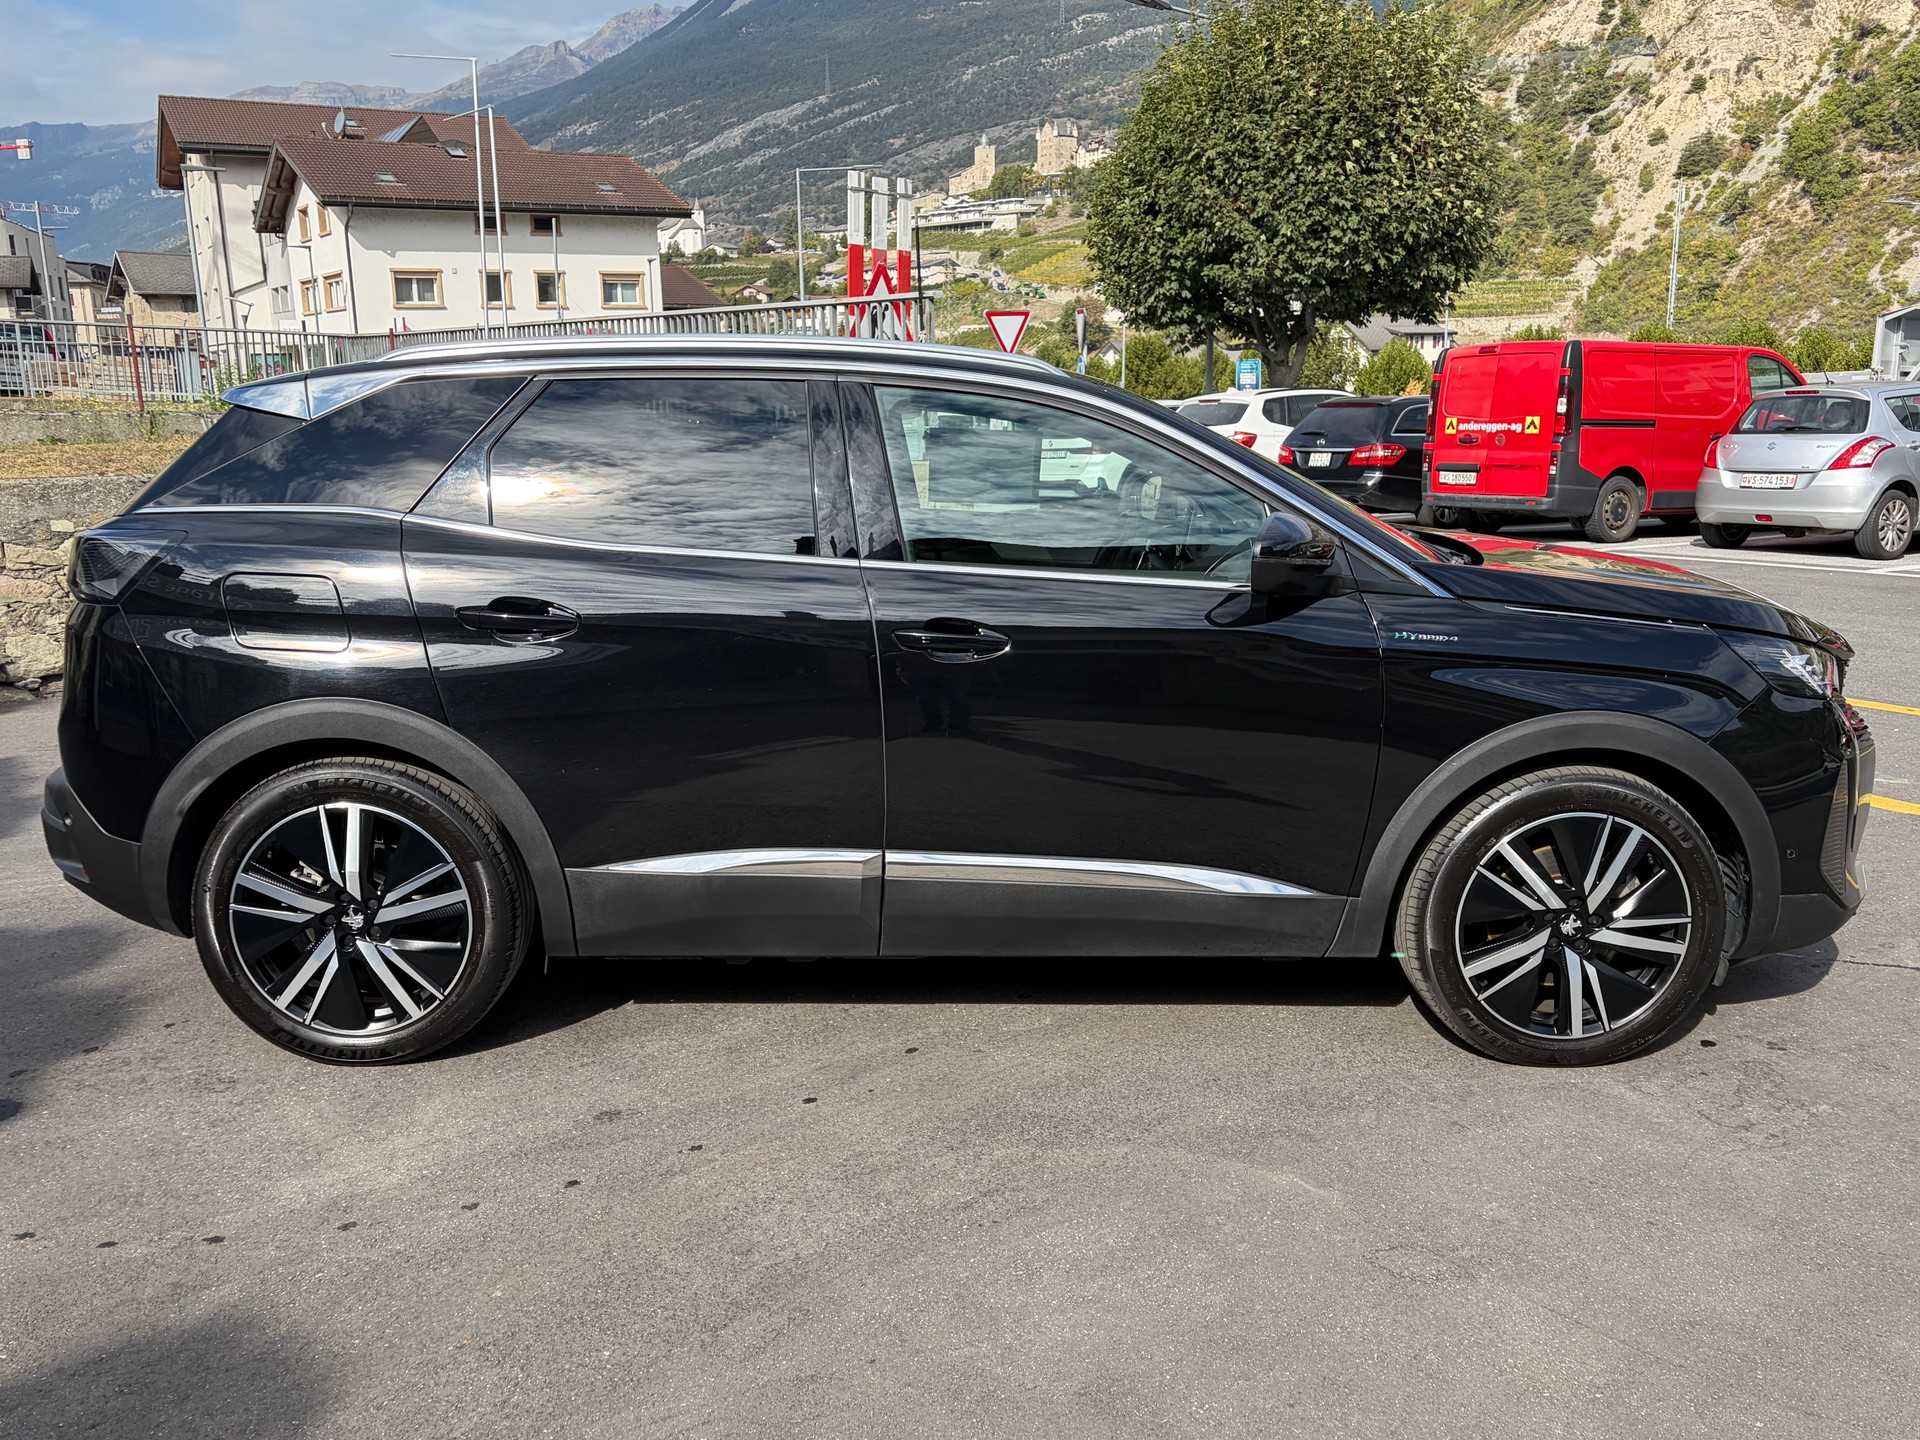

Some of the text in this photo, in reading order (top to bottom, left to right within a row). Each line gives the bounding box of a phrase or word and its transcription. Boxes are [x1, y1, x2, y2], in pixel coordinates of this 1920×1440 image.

[1458, 421, 1522, 433] andereggen-ag
[317, 778, 427, 807] MICHELIN
[1600, 789, 1694, 844] MICHELIN
